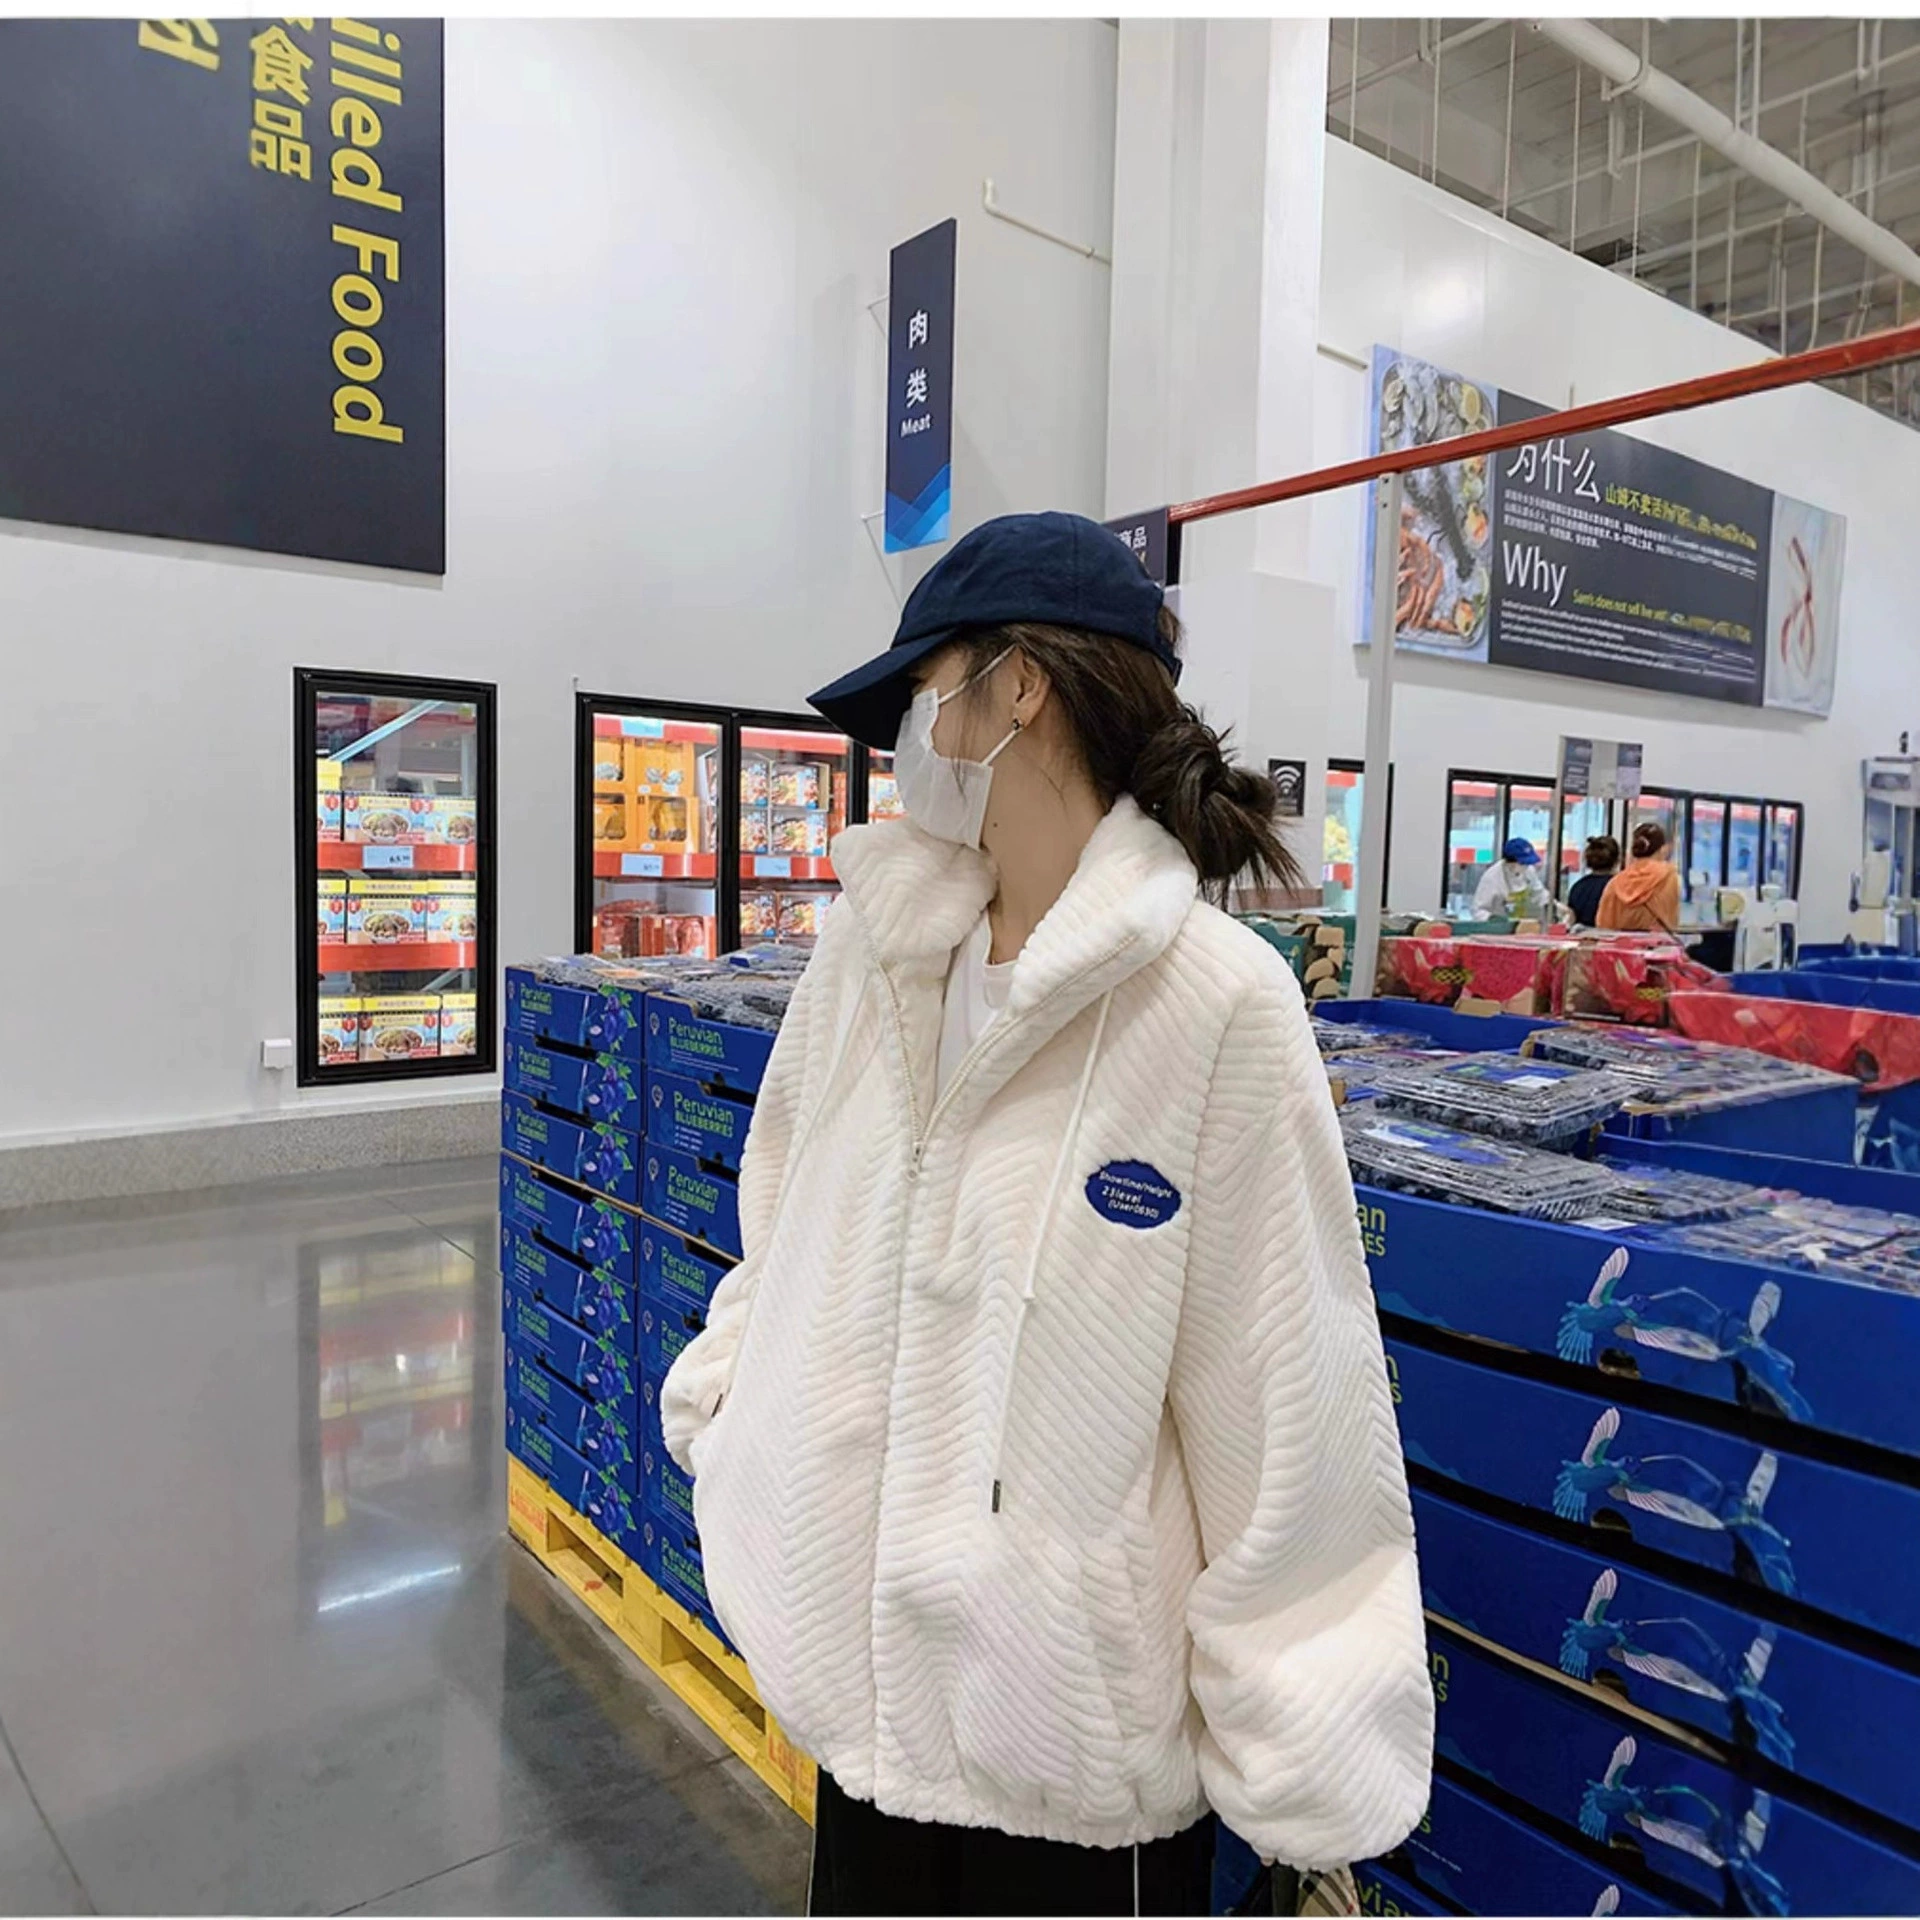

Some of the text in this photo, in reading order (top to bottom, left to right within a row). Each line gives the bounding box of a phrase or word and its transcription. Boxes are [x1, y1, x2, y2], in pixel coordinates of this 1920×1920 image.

[249, 18, 314, 181] 食品
[331, 224, 404, 444] Food
[905, 309, 929, 409] 肉类
[900, 413, 931, 438] Meat
[1506, 438, 1601, 503] 为什么
[1503, 540, 1568, 608] Why
[668, 1017, 723, 1046] Peruvian
[673, 1091, 734, 1125] Peruvian
[668, 1165, 719, 1201] Peruvian
[1361, 1231, 1387, 1257] ES
[1357, 1880, 1411, 1917] via
